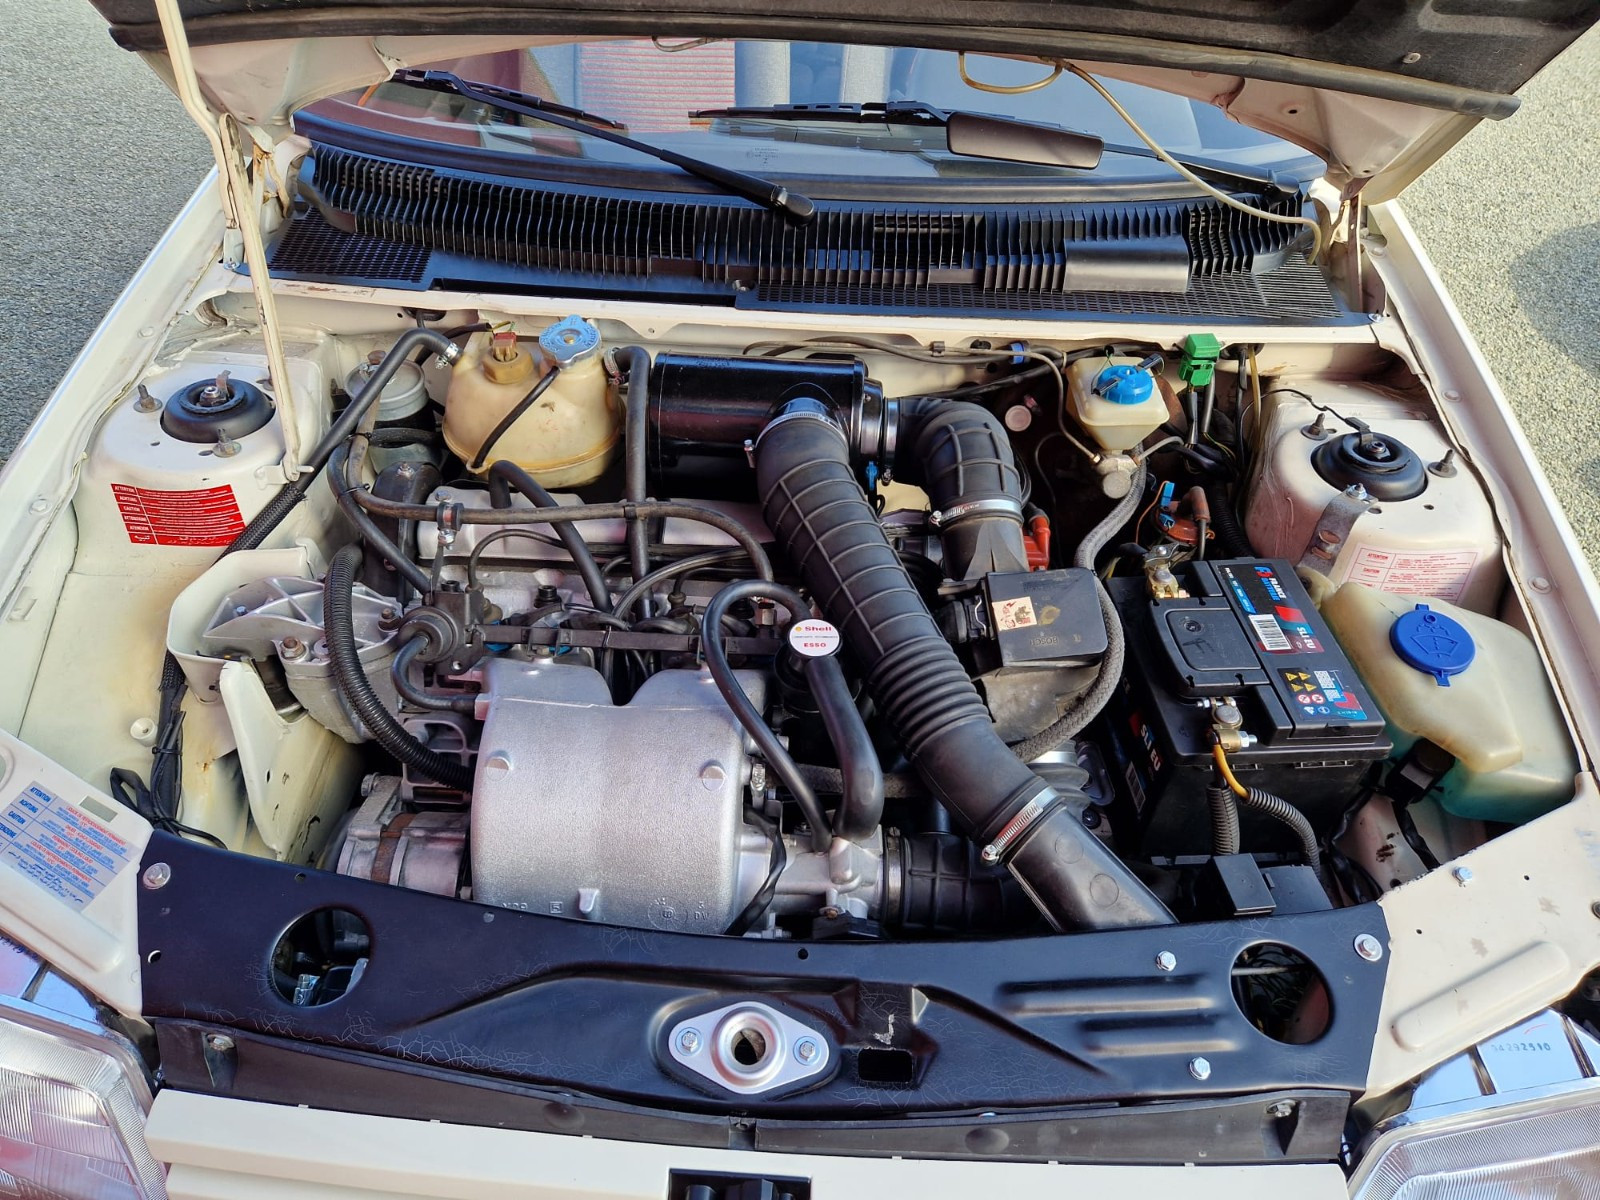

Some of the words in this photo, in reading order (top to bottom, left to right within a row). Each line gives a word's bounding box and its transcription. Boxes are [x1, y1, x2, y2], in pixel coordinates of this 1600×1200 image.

[1297, 627, 1310, 638] SLI
[1304, 639, 1316, 649] EU
[1140, 723, 1152, 751] SLI
[1150, 748, 1161, 772] EU
[30, 786, 52, 803] ATTENTION
[7, 810, 26, 825] CAUTION
